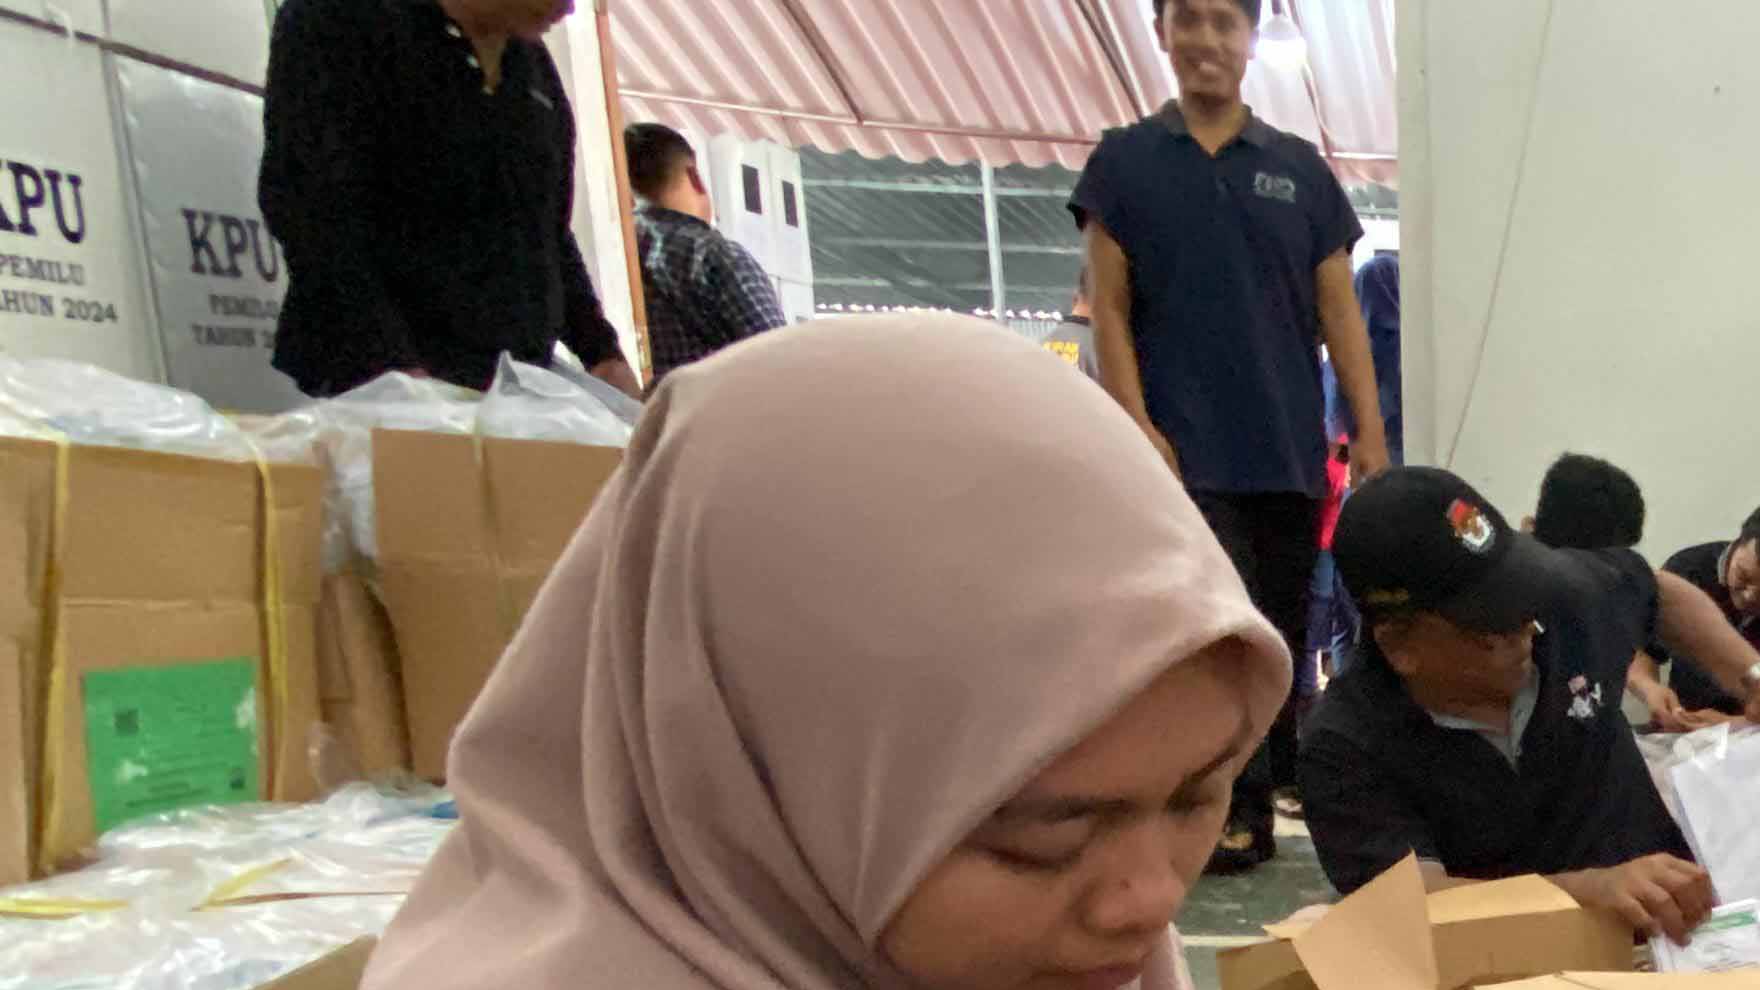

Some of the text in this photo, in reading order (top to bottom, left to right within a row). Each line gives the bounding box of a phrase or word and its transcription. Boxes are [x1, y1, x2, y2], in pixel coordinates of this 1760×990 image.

[181, 207, 279, 283] KPU
[0, 289, 119, 323] HUN 2024
